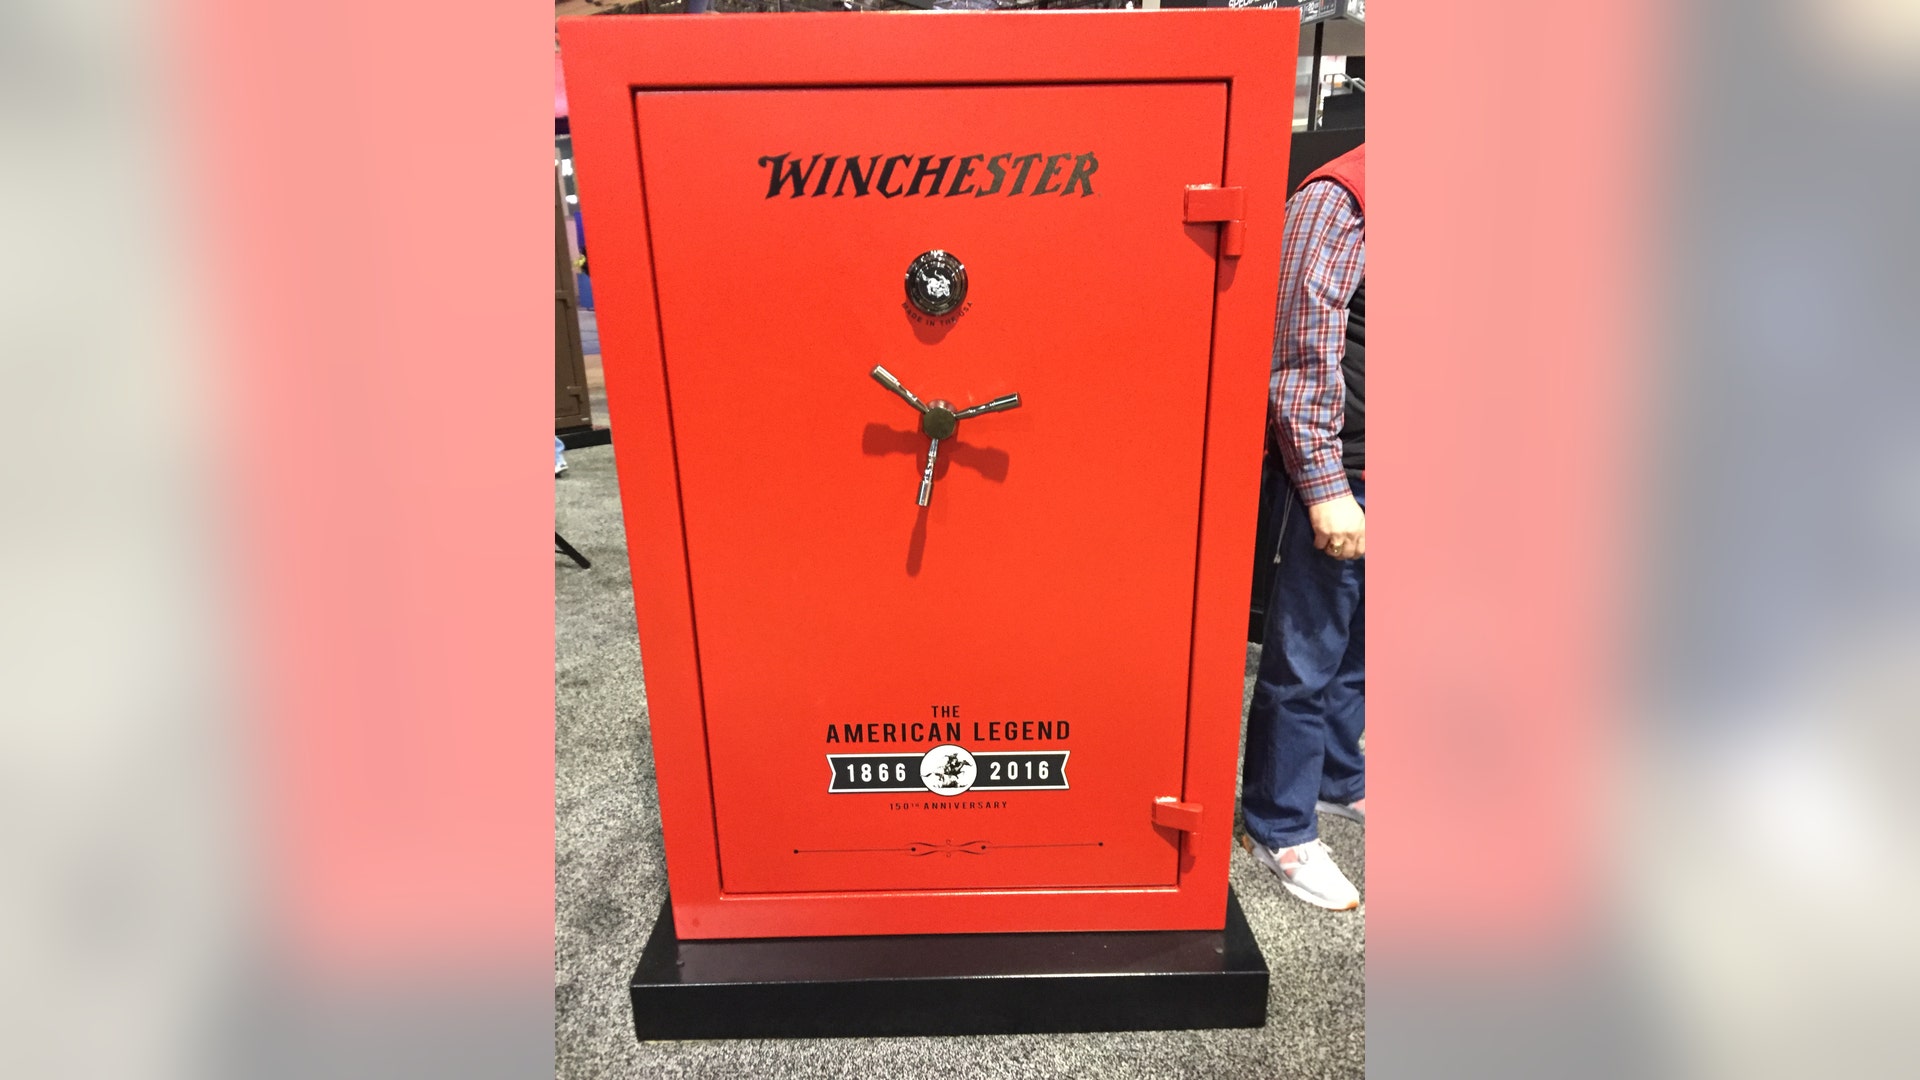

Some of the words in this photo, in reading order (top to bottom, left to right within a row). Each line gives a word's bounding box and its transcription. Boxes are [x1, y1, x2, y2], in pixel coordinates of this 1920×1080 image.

[758, 151, 1099, 199] WINCHESTER
[901, 300, 922, 323] MADE
[940, 316, 958, 326] THE
[959, 300, 973, 317] USA
[931, 705, 960, 718] THE
[826, 722, 962, 743] AMERICAN
[974, 720, 1070, 741] LEGEND
[847, 763, 906, 783] 1866
[990, 761, 1049, 780] 2016
[923, 801, 1008, 810] ANNIVERSARY
